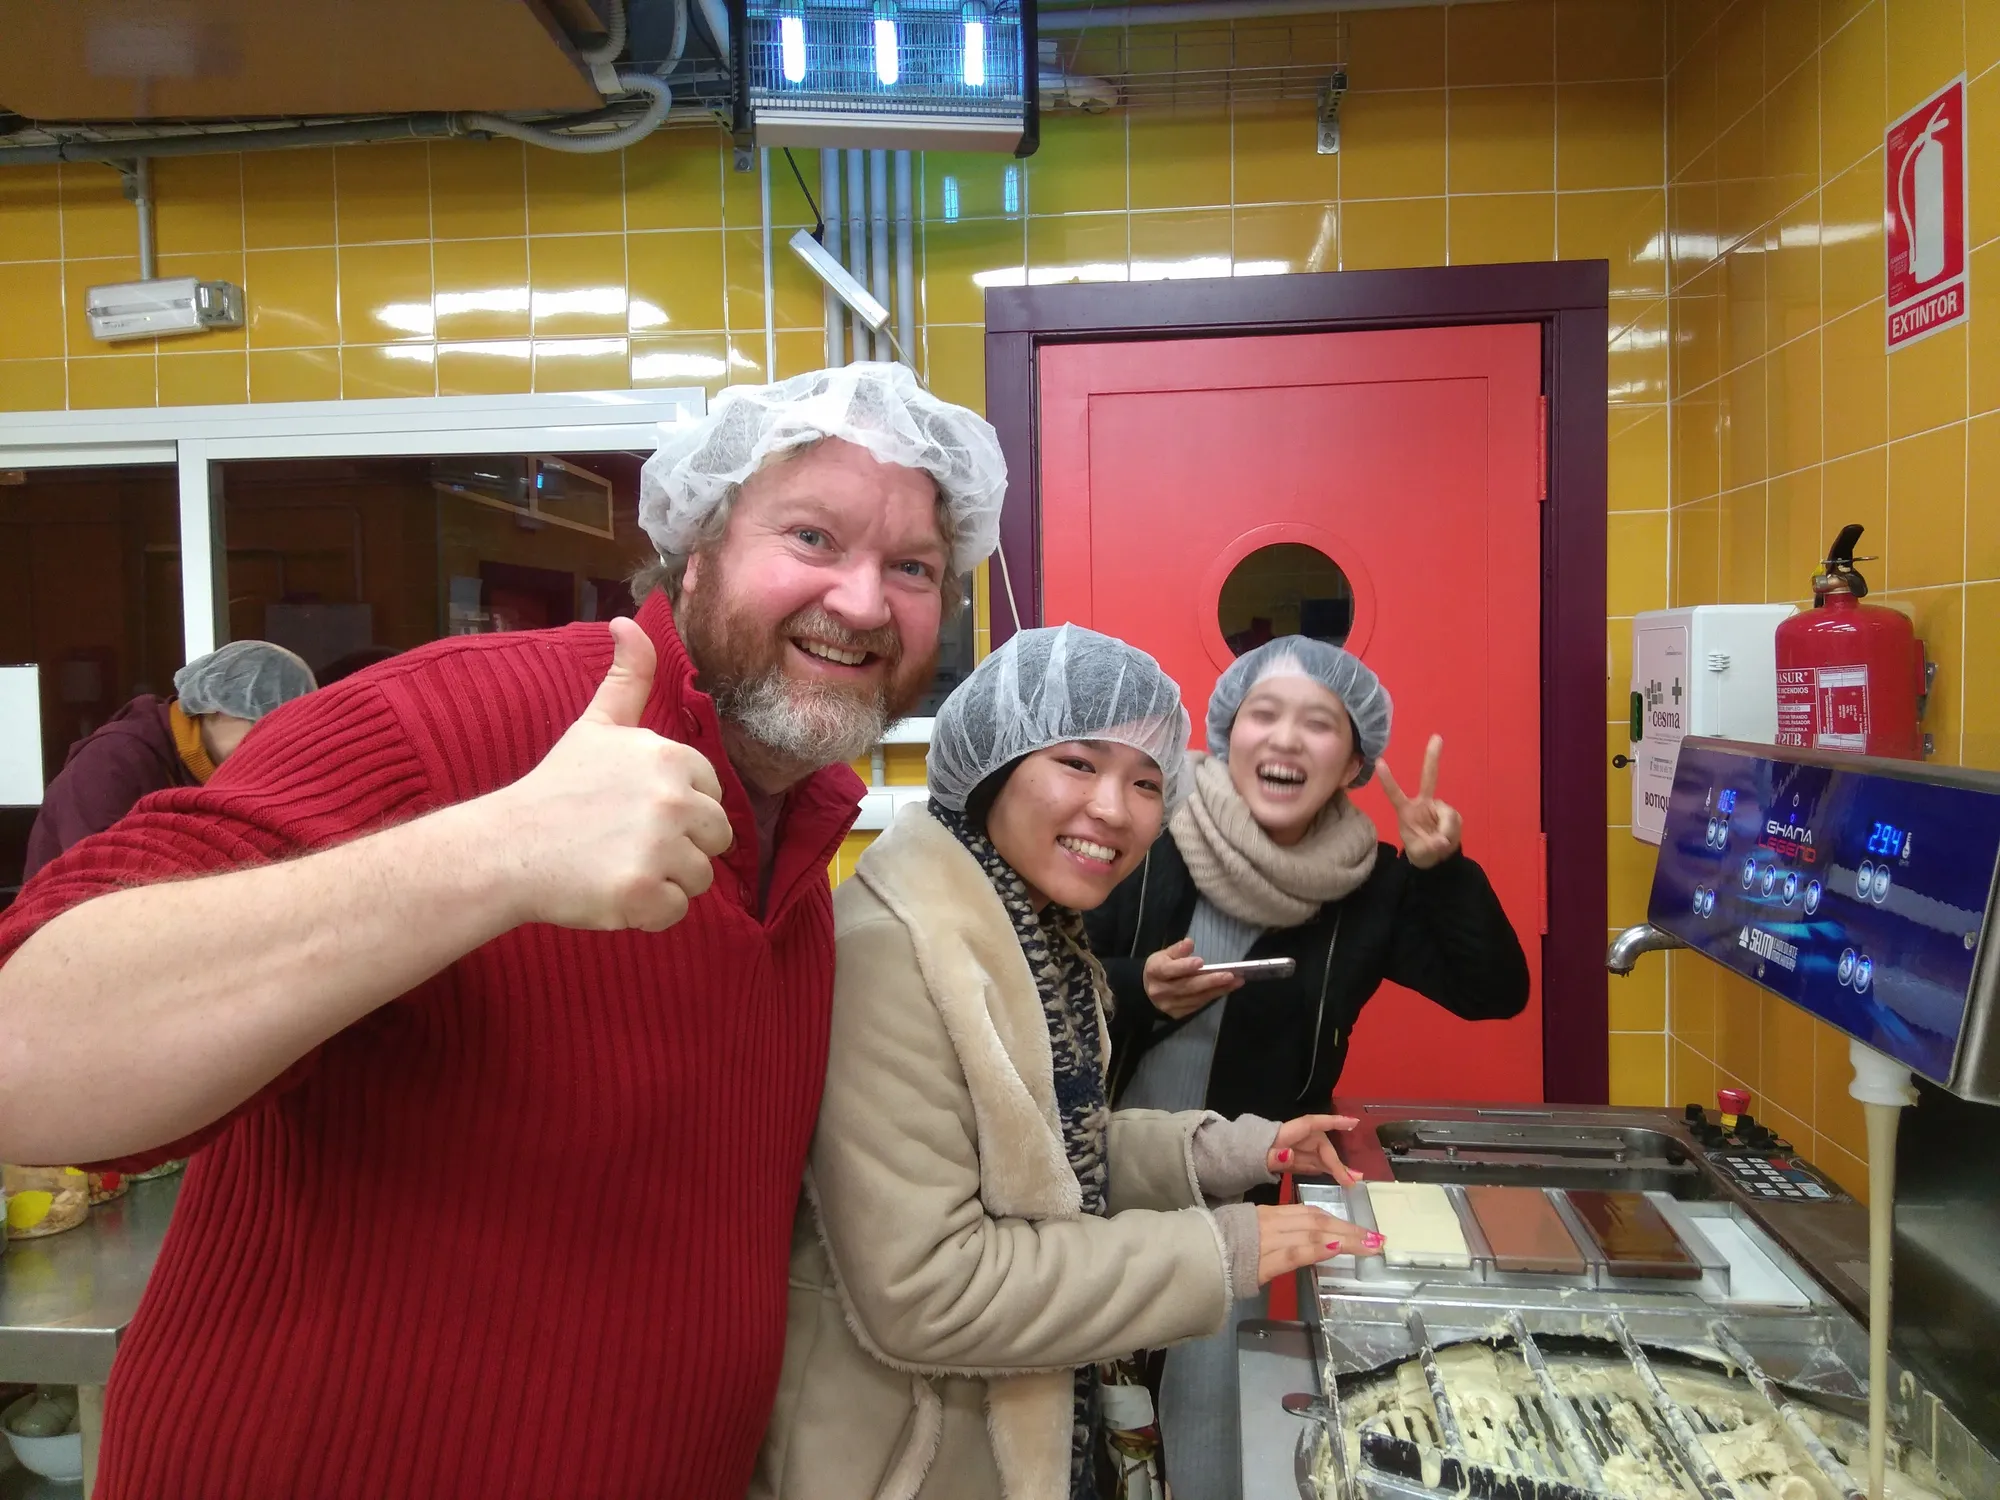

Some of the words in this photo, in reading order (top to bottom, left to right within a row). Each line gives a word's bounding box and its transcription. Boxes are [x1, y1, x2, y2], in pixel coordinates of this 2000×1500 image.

[1892, 290, 1958, 339] EXTINTOR
[1652, 710, 1681, 729] cesma
[1757, 832, 1817, 863] LEGEND
[1766, 820, 1813, 845] GHANA
[1749, 928, 1775, 960] SELMI
